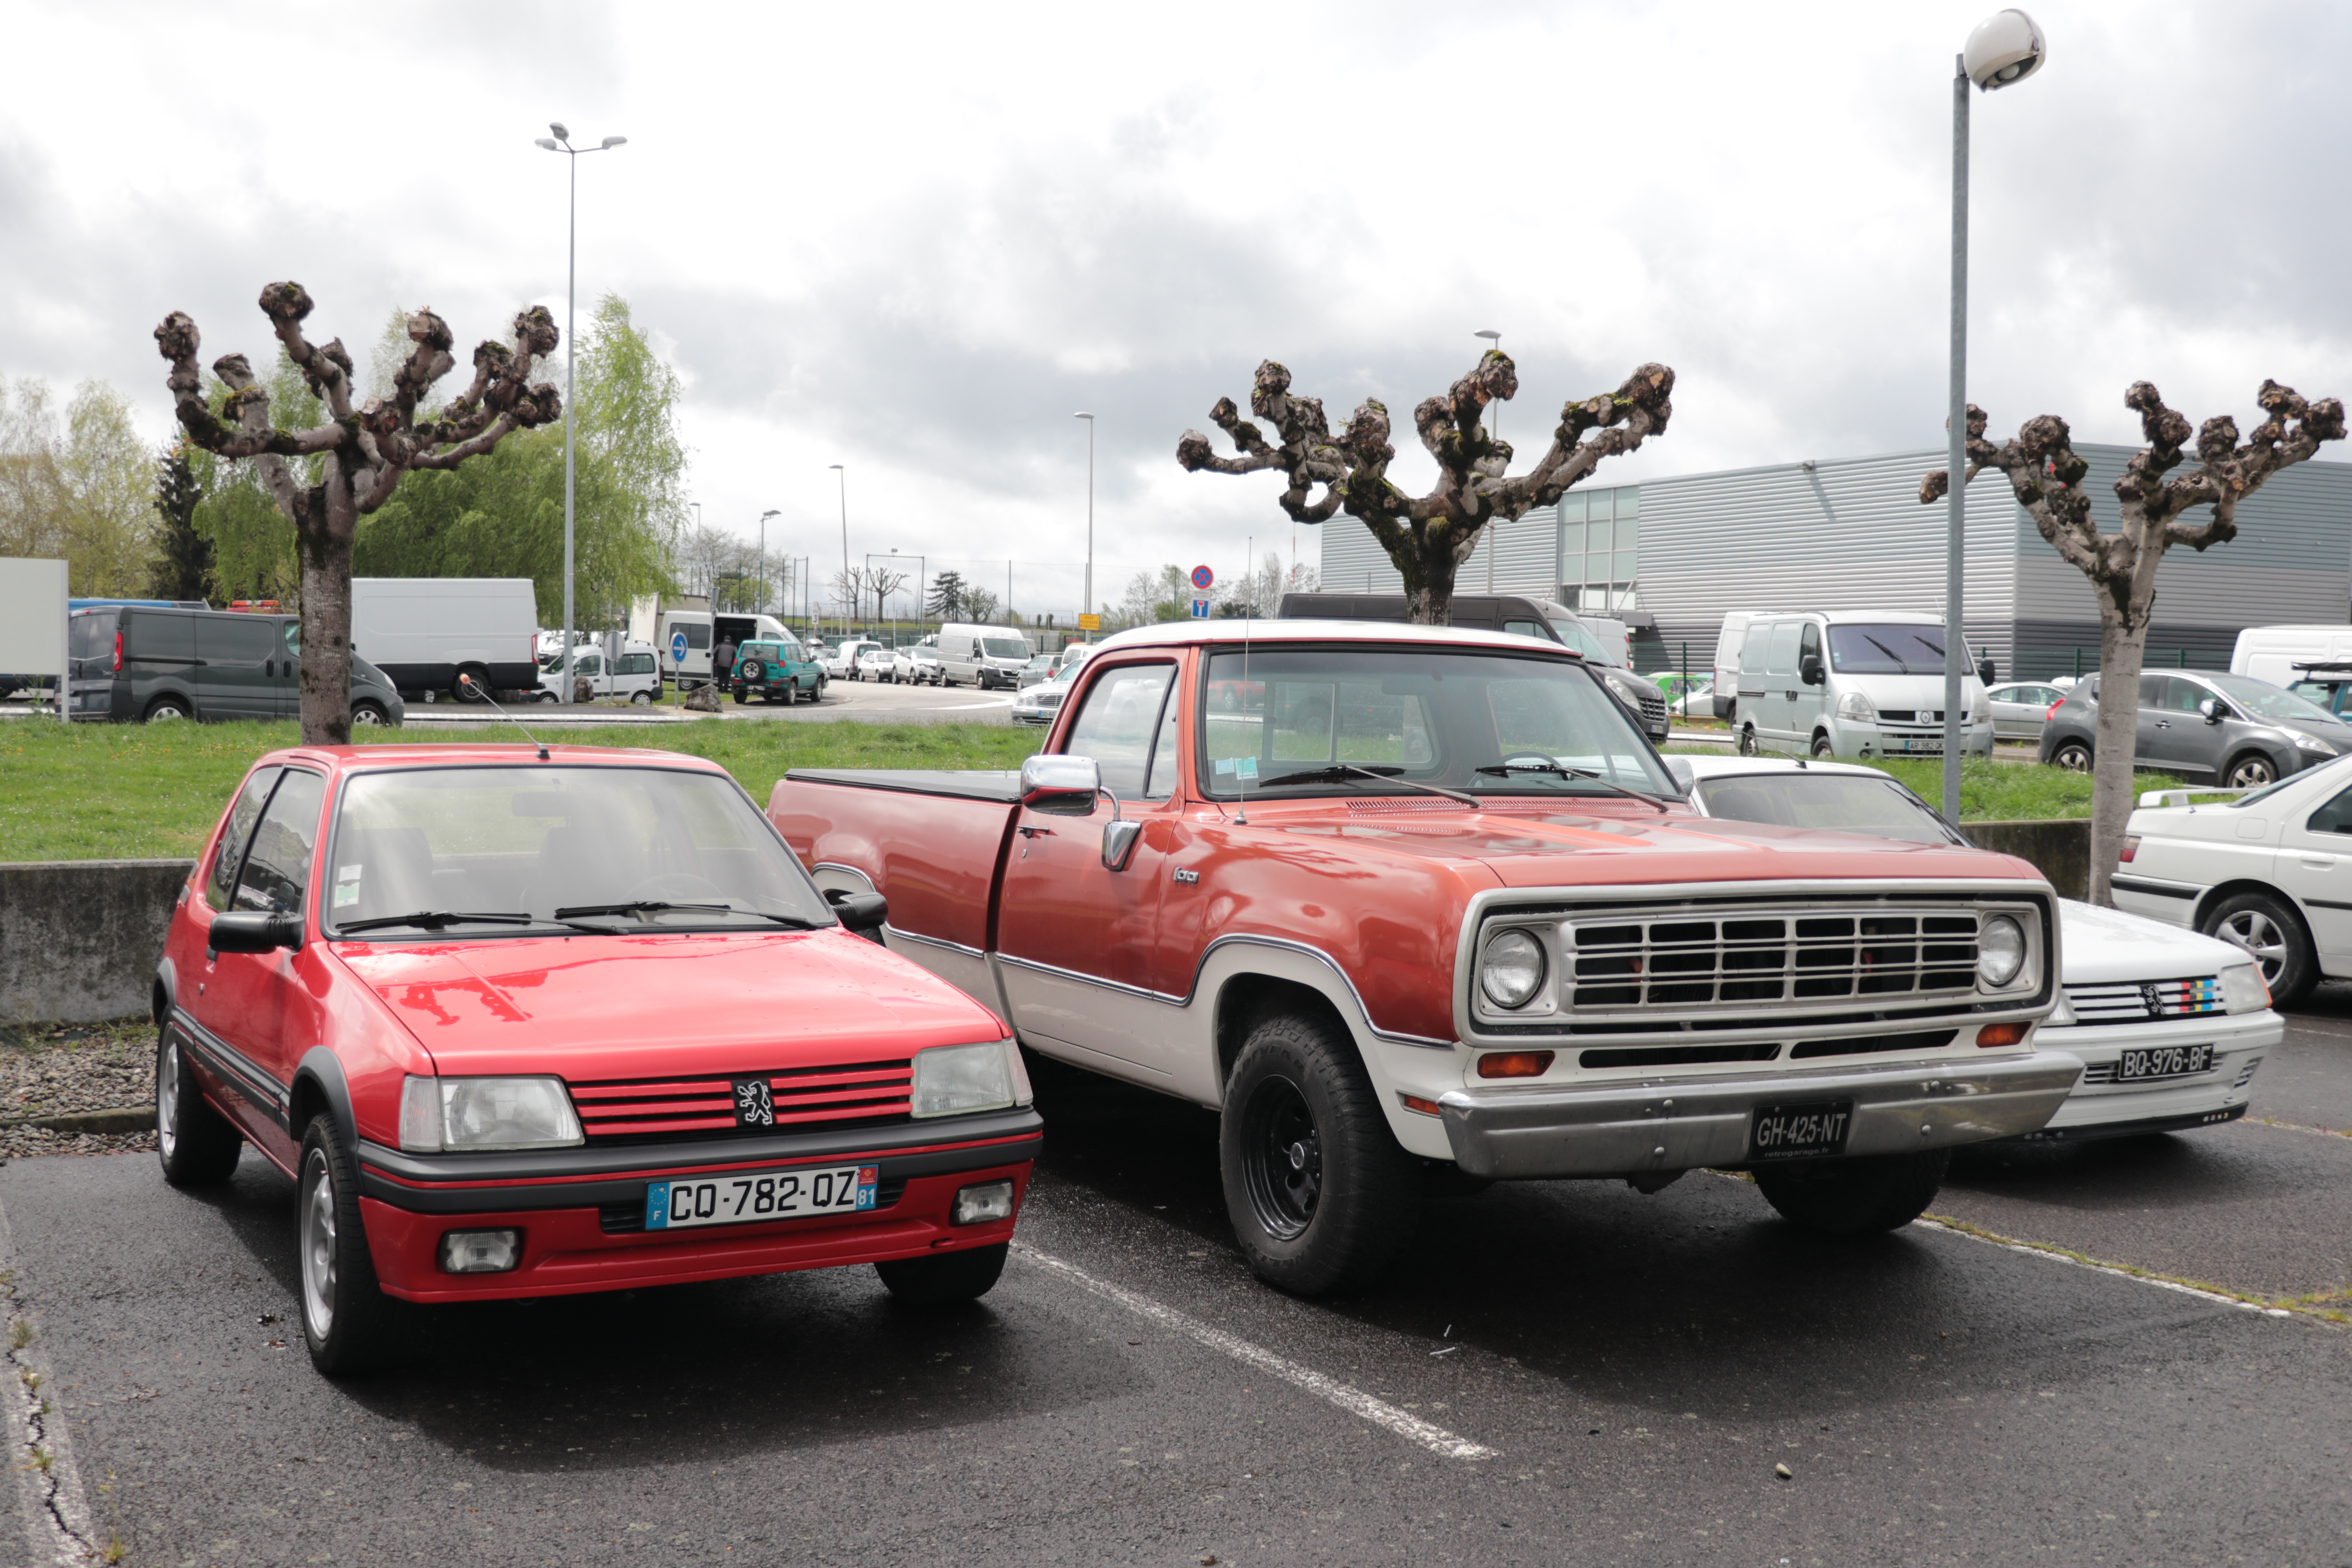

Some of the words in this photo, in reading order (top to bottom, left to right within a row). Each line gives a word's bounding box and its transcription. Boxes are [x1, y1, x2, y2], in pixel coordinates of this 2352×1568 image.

[1172, 867, 1199, 884] 100
[2123, 1045, 2211, 1076] BQ-976-BF
[1757, 1113, 1847, 1146] GH-425-NT
[1765, 1147, 1829, 1157] retrogarage.fr
[670, 1171, 856, 1221] CQ-782-QZ
[858, 1188, 875, 1206] 81
[653, 1210, 661, 1220] F
